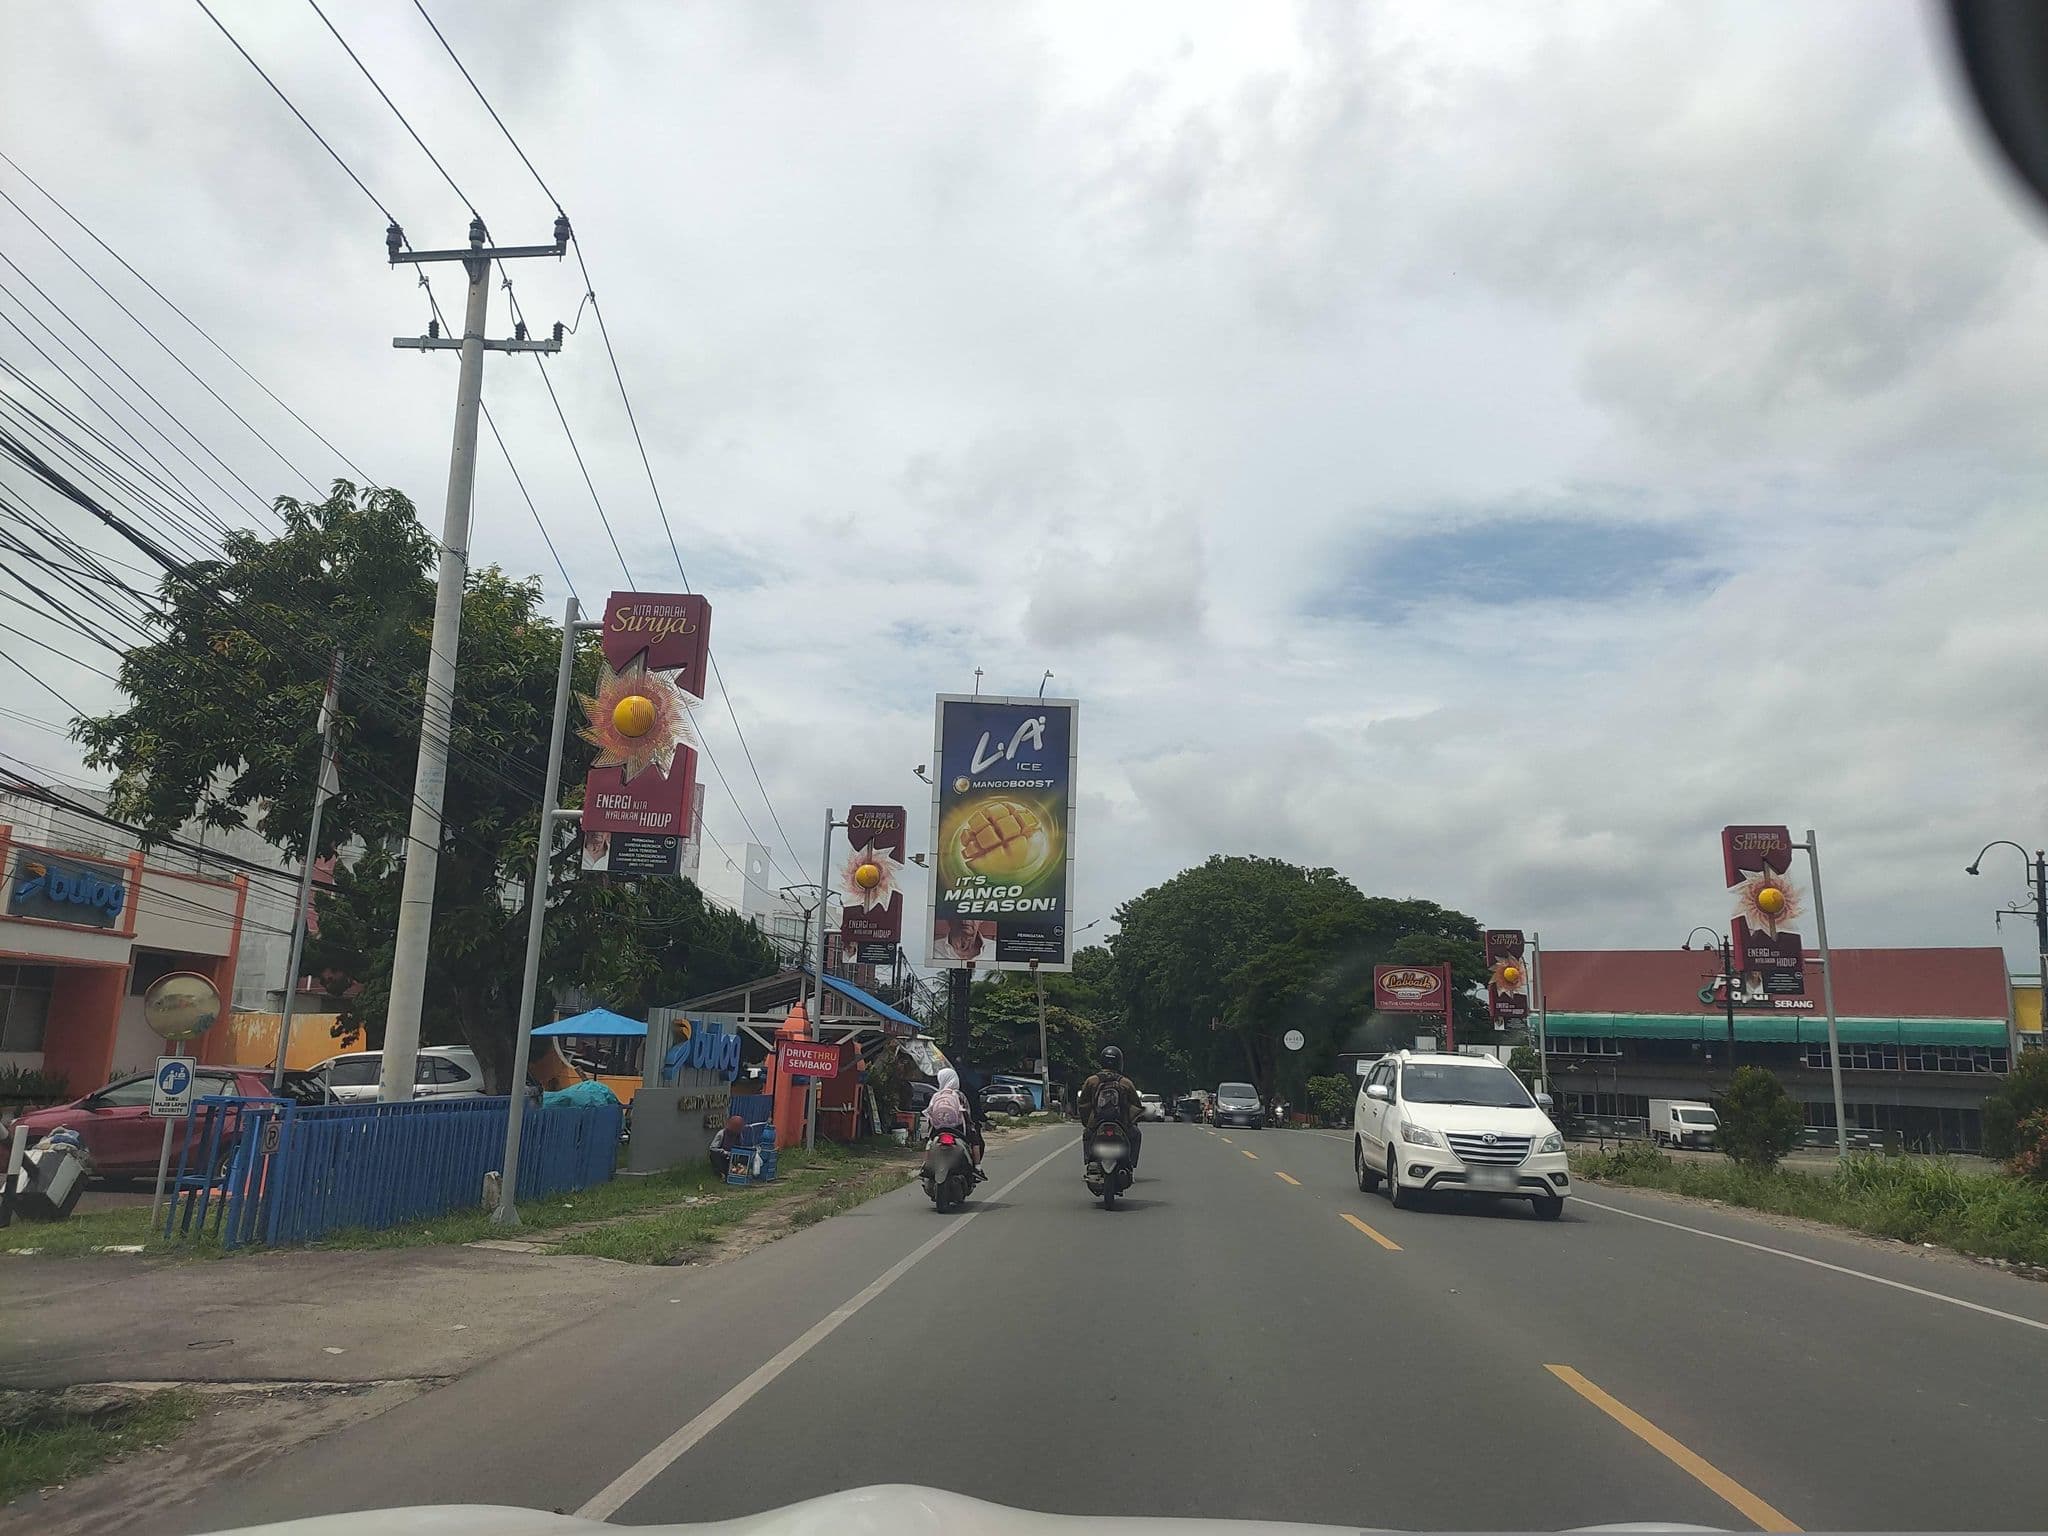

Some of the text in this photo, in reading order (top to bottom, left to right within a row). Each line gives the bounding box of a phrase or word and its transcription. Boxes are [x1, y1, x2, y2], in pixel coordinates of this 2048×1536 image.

[633, 604, 687, 618] KITA ADALAH
[610, 607, 697, 644] Surya
[1016, 762, 1042, 771] ICE
[972, 780, 1055, 788] MANGOBOOST
[596, 793, 632, 810] ENERGI
[605, 810, 672, 828] NYALAKAN HIDUP
[851, 813, 900, 835] Surya
[1733, 835, 1787, 857] Surya
[955, 875, 987, 887] IT'S
[47, 866, 125, 916] bulog
[944, 885, 1023, 901] MANGO
[956, 898, 1057, 914] SEASON!
[848, 920, 869, 928] ENERGI
[1748, 948, 1770, 957] ENERGI
[1776, 957, 1797, 967] HIDUP
[1774, 1000, 1814, 1008] SERANG
[691, 1019, 742, 1082] bulog
[789, 1059, 832, 1071] SEMBAKO
